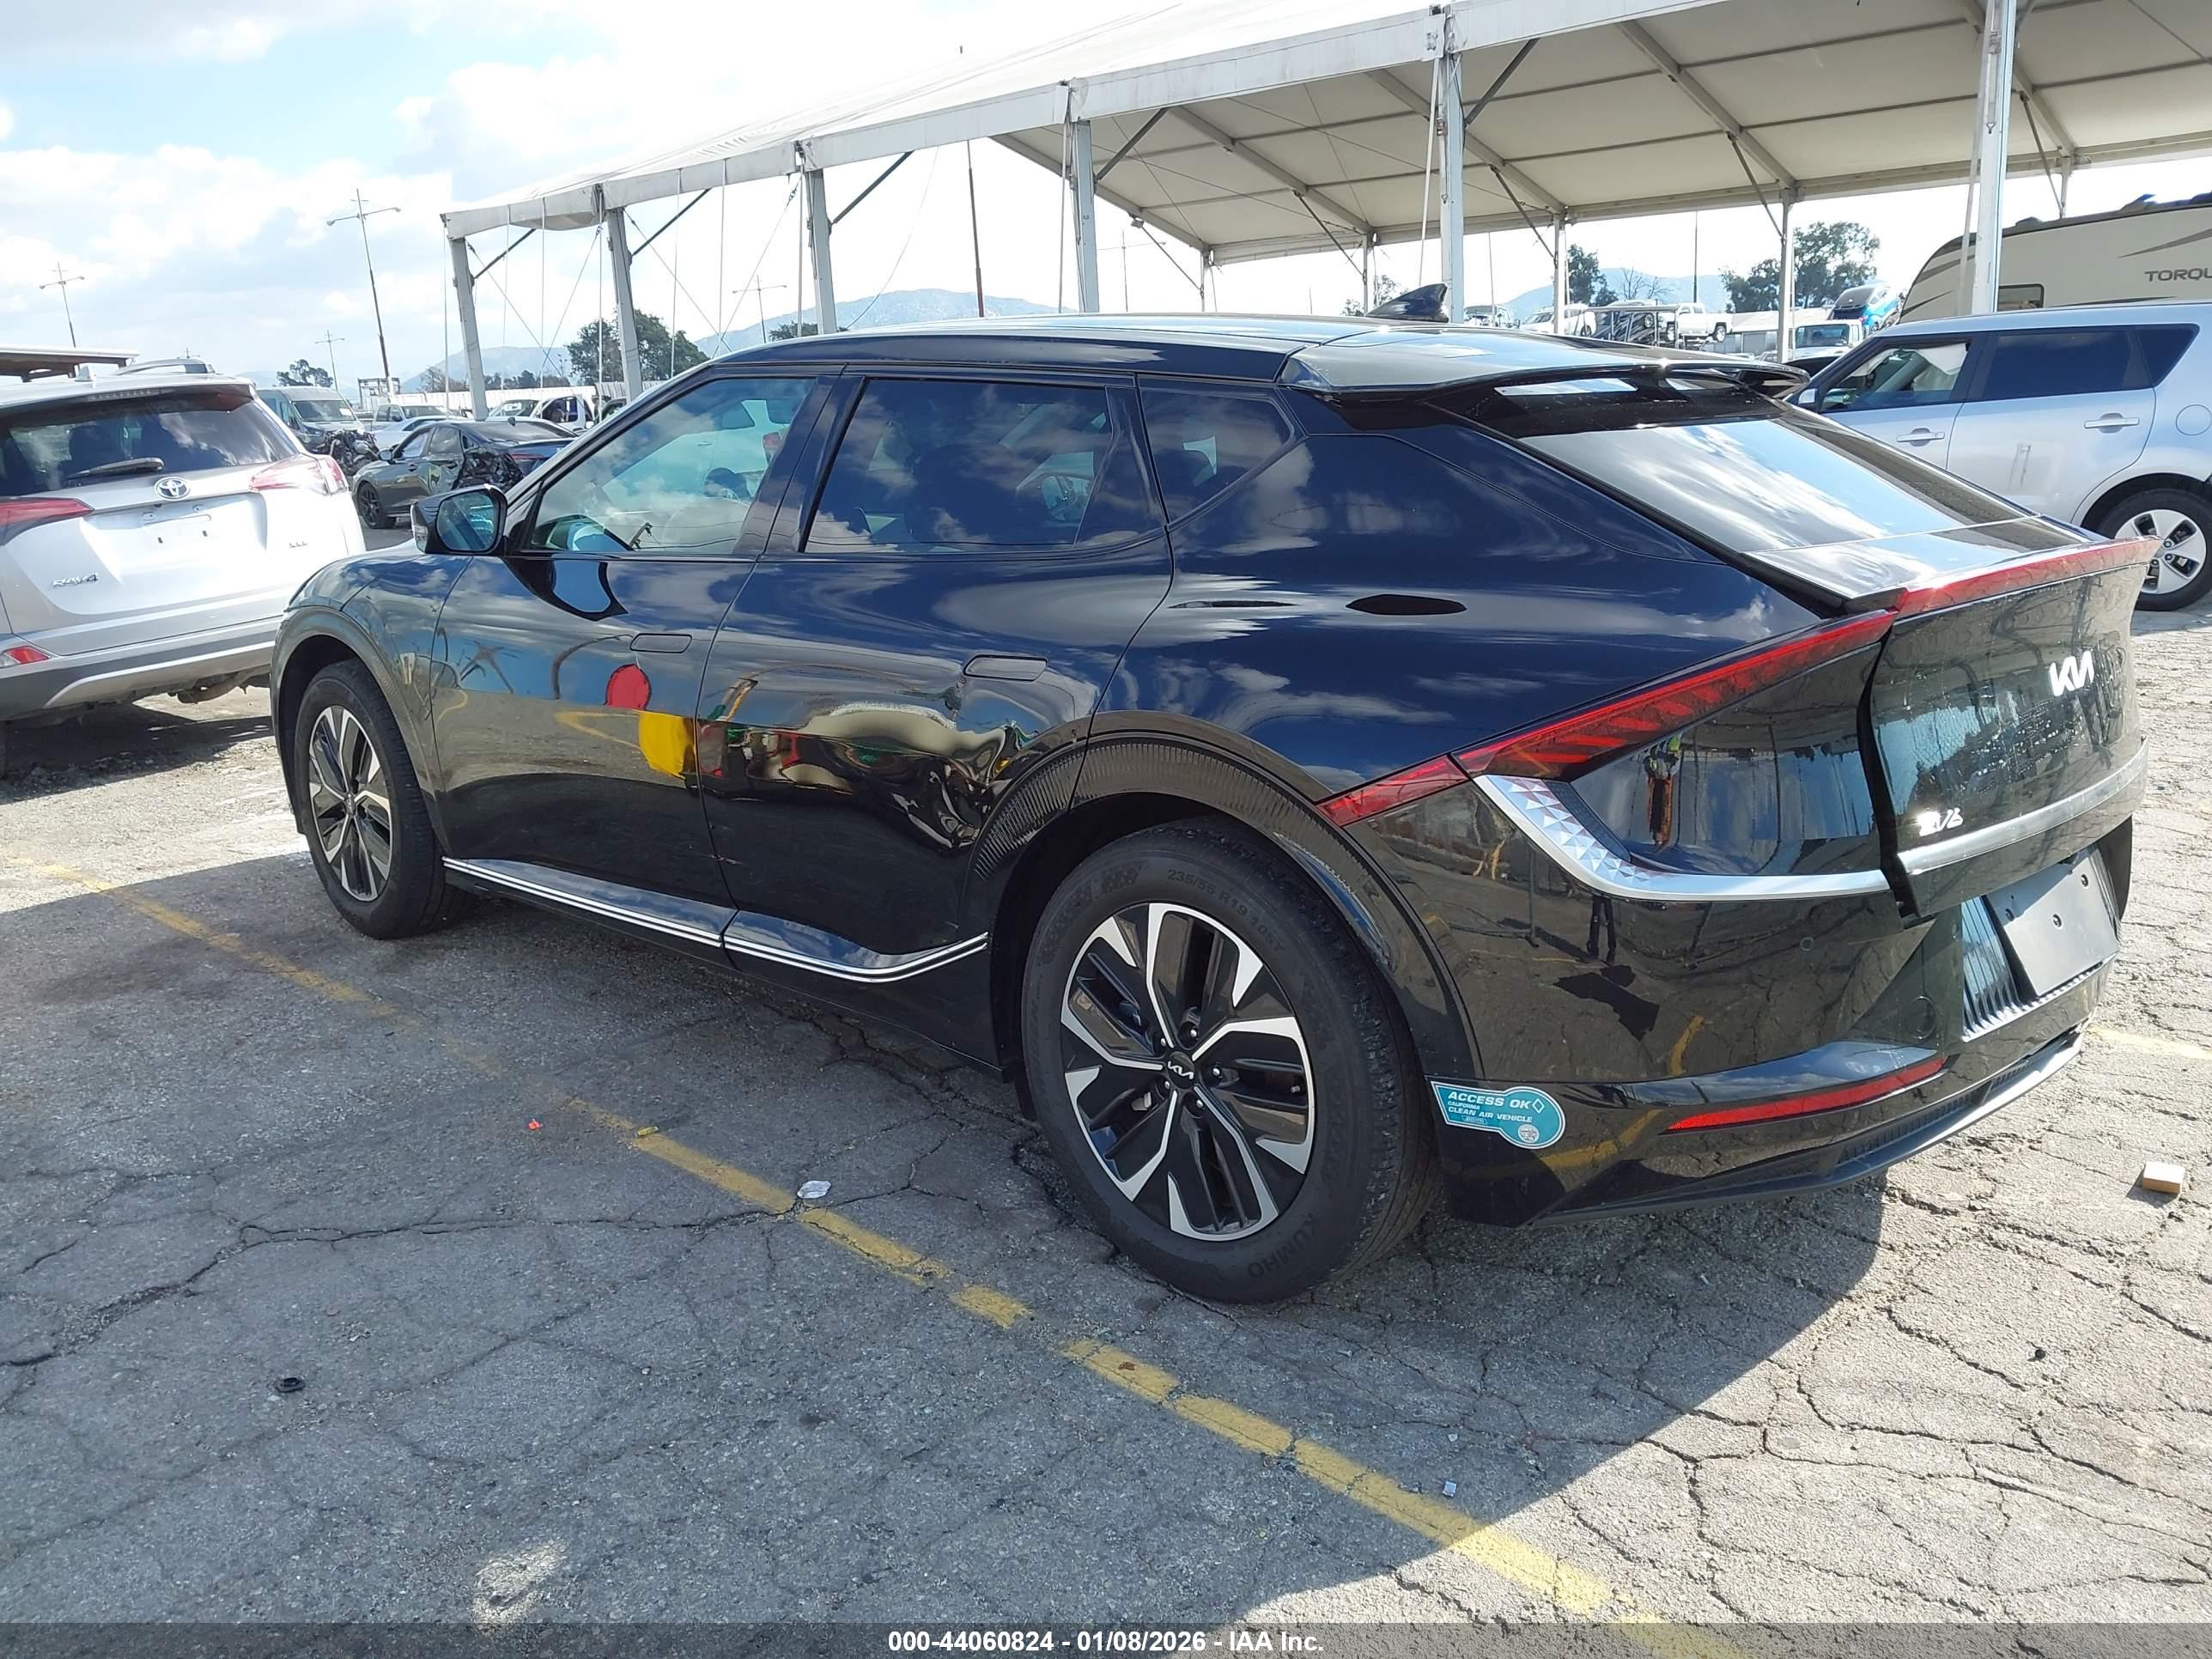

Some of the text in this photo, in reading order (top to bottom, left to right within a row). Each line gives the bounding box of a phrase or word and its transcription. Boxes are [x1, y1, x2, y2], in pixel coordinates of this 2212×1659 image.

[1447, 1100, 1480, 1110] CALIFORNIA
[1448, 1091, 1532, 1109] ACCESS OK
[1448, 1106, 1476, 1115] CLEAN
[1497, 1113, 1533, 1123] VEHICLE
